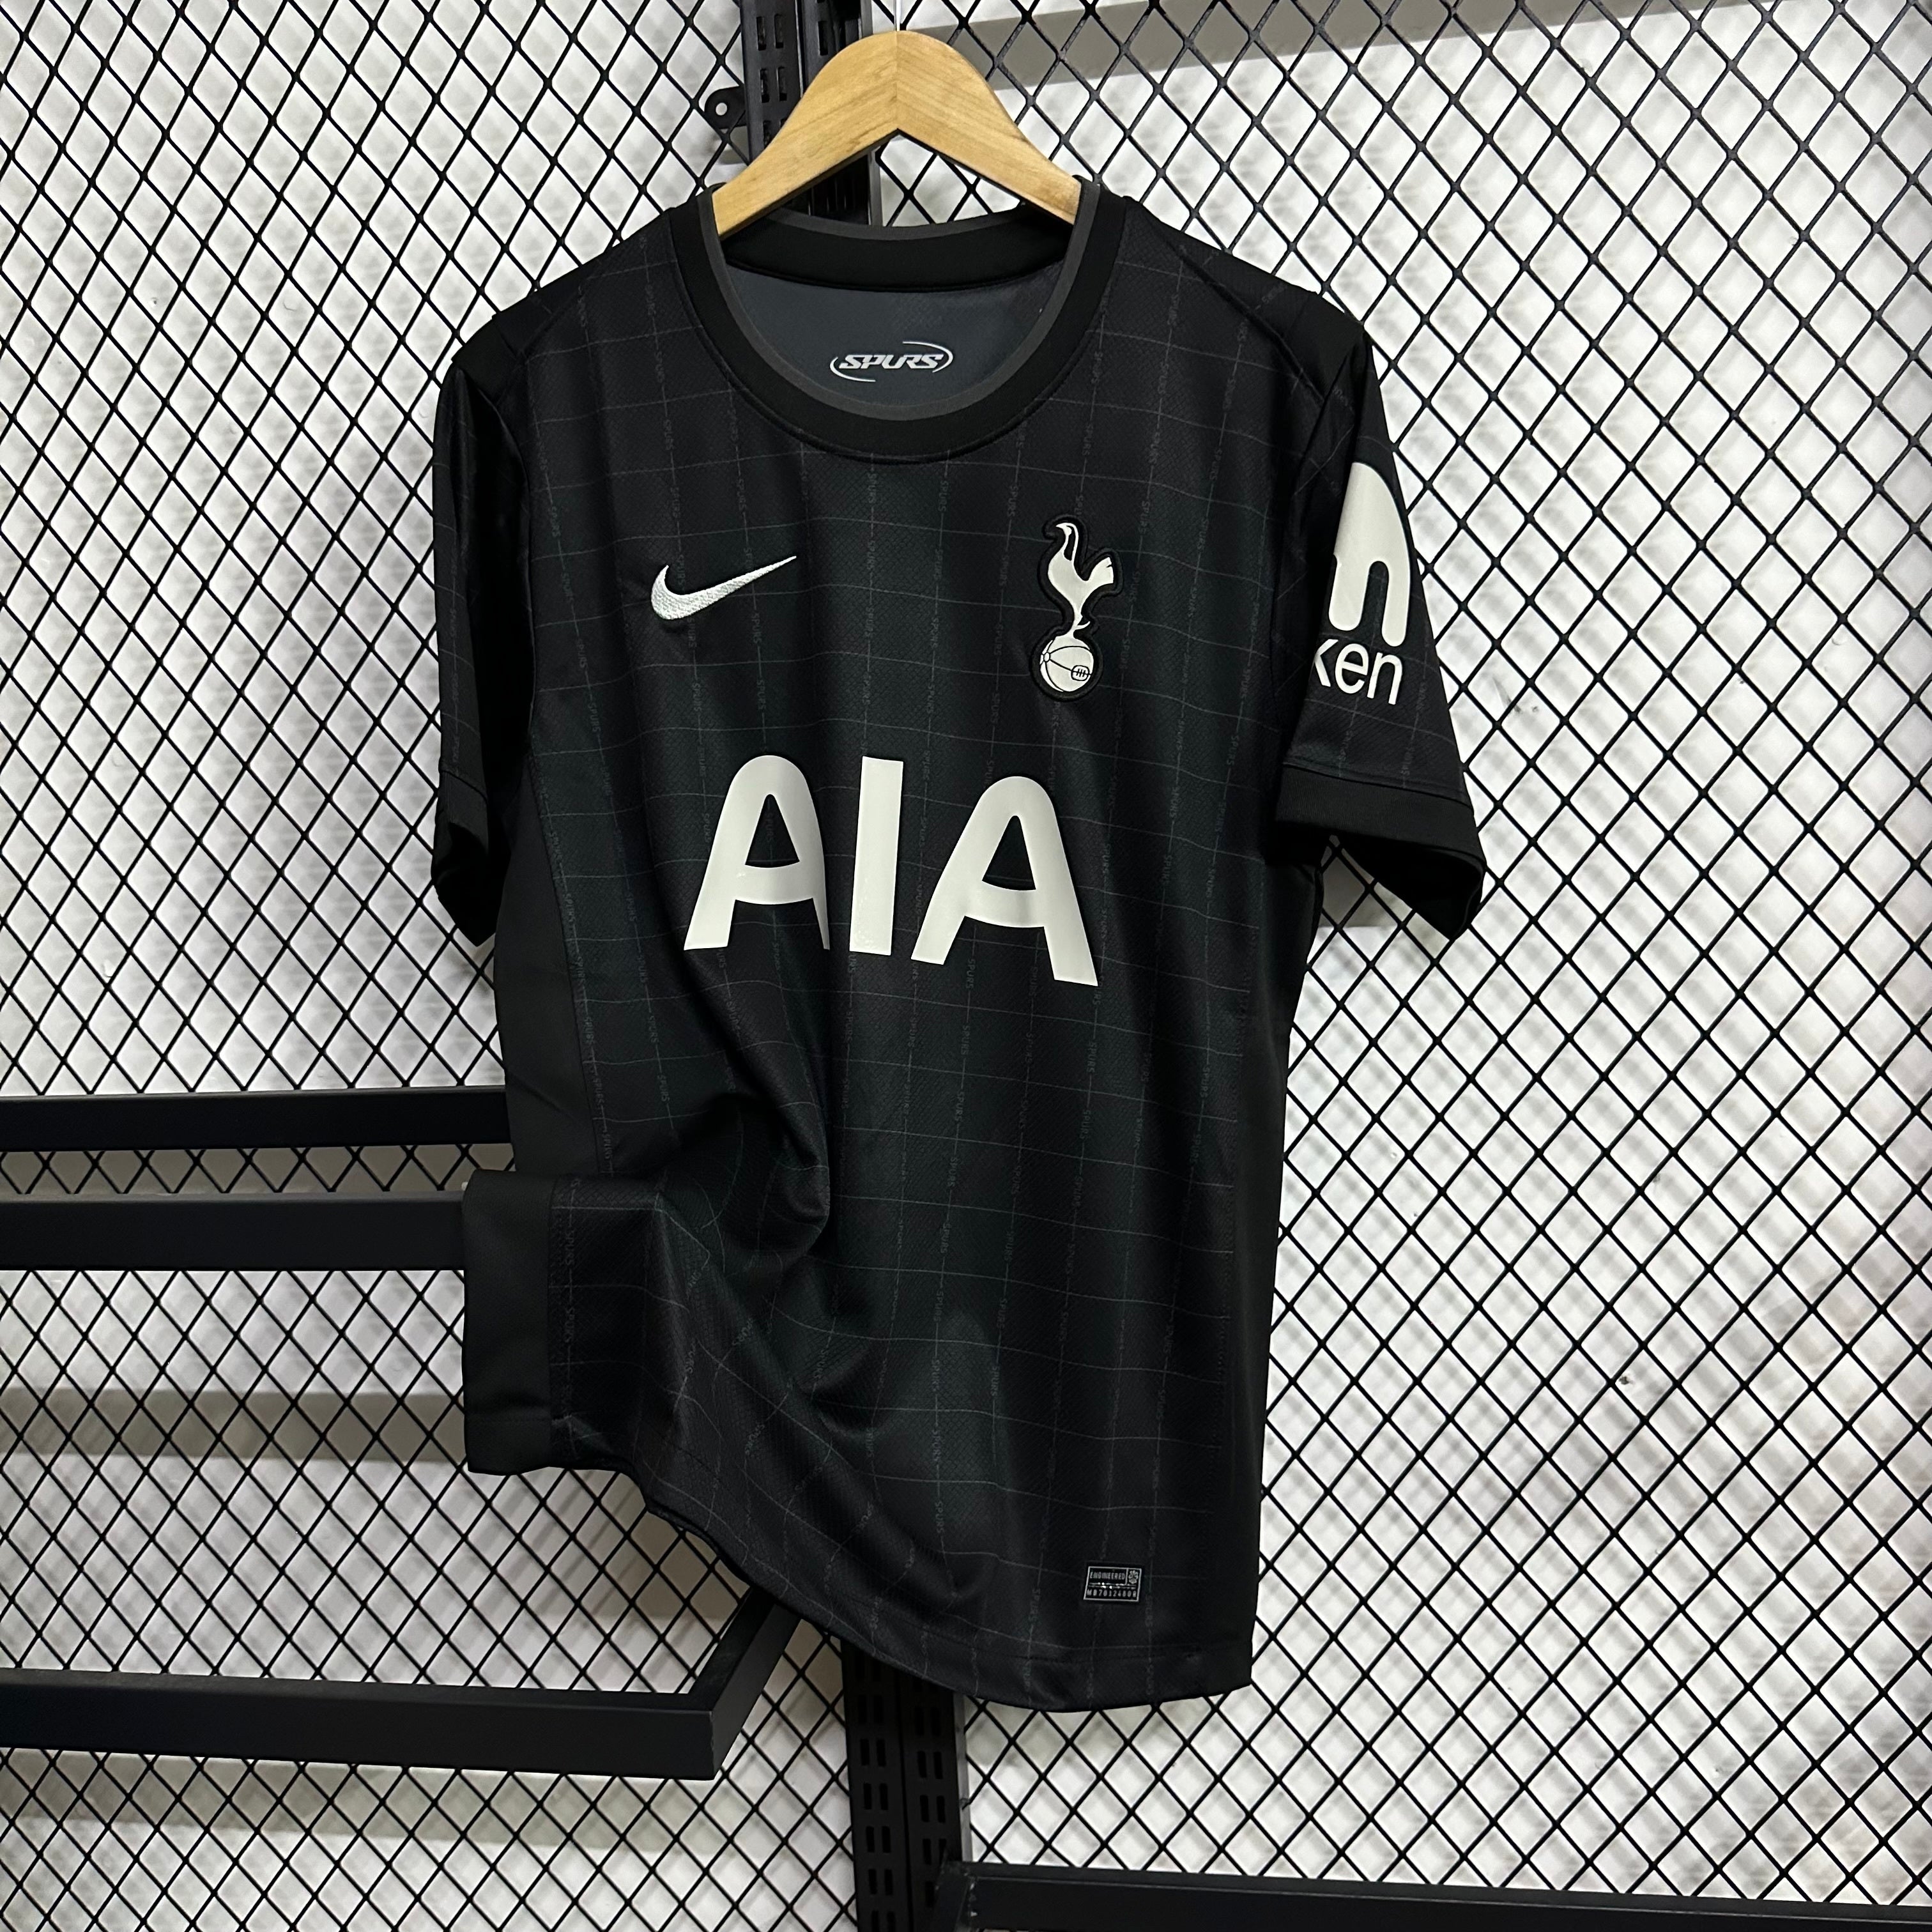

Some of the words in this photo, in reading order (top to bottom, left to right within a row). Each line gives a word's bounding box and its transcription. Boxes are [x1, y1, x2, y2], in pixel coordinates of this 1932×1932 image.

[838, 354, 944, 369] SPURS
[683, 755, 1098, 987] AIA
[1089, 1571, 1125, 1580] ENGINEERED
